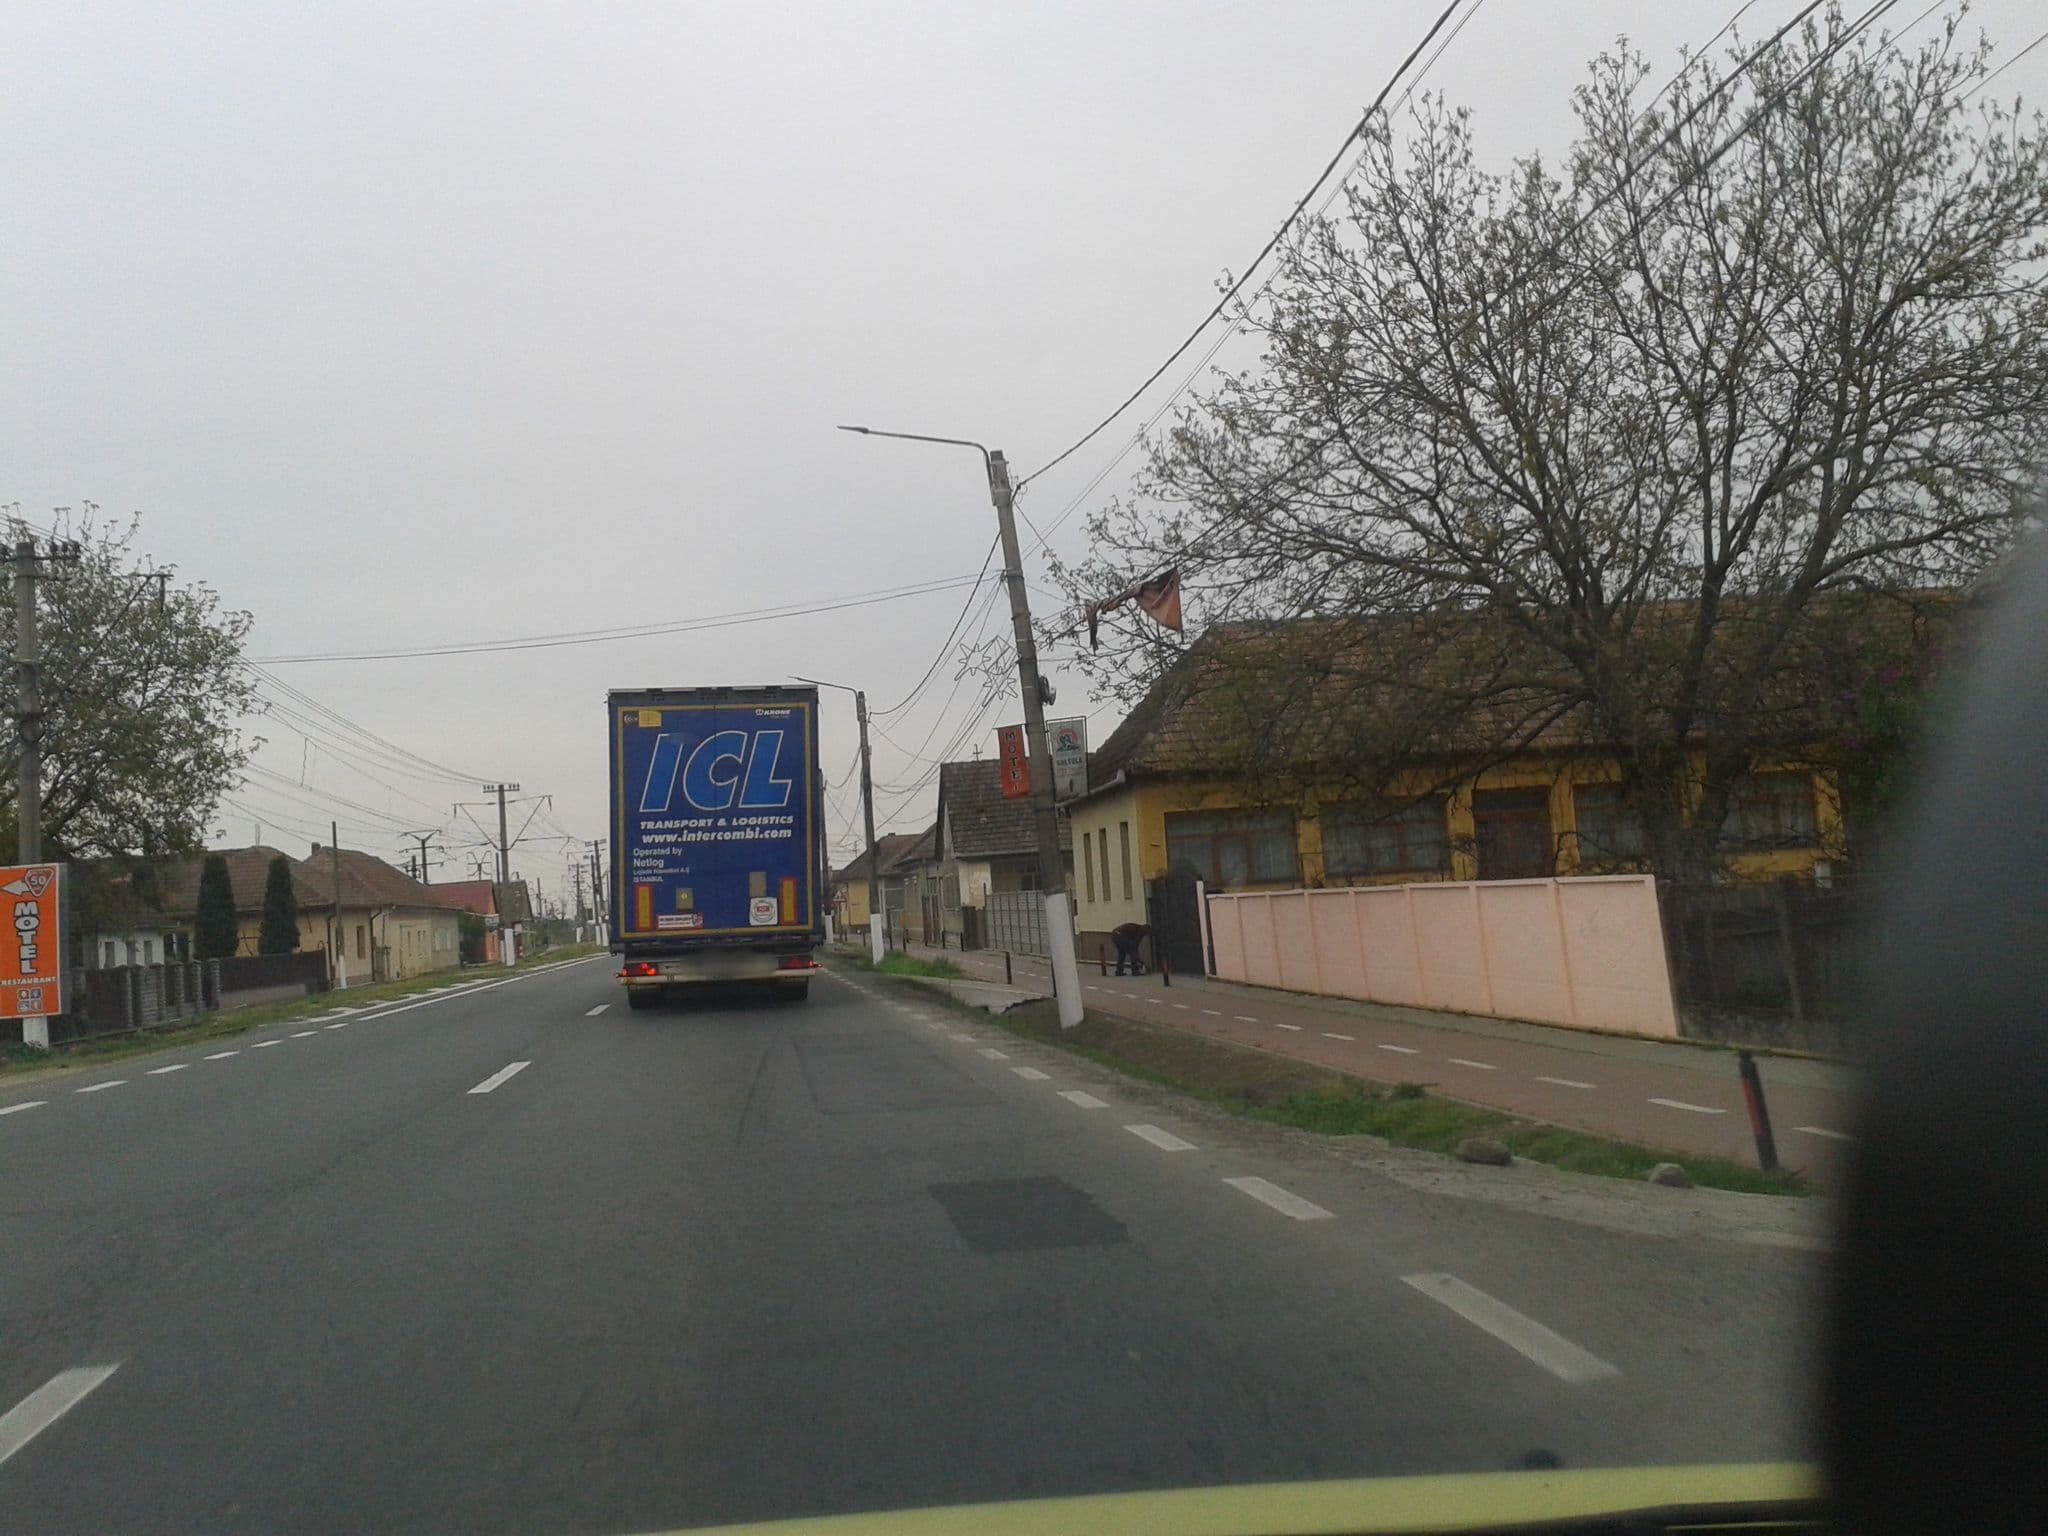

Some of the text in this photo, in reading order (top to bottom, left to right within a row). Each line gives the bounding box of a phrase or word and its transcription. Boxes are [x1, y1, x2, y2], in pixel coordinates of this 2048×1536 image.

[639, 730, 792, 812] ICL
[640, 816, 794, 829] TRANSPORT & LOGISTICS
[642, 827, 792, 843] www.intercombi.com
[633, 847, 682, 857] Operated by
[633, 858, 664, 868] Netlog
[30, 876, 46, 886] 50
[14, 901, 40, 974] MOTEL
[1, 976, 56, 986] RESTAURANT
